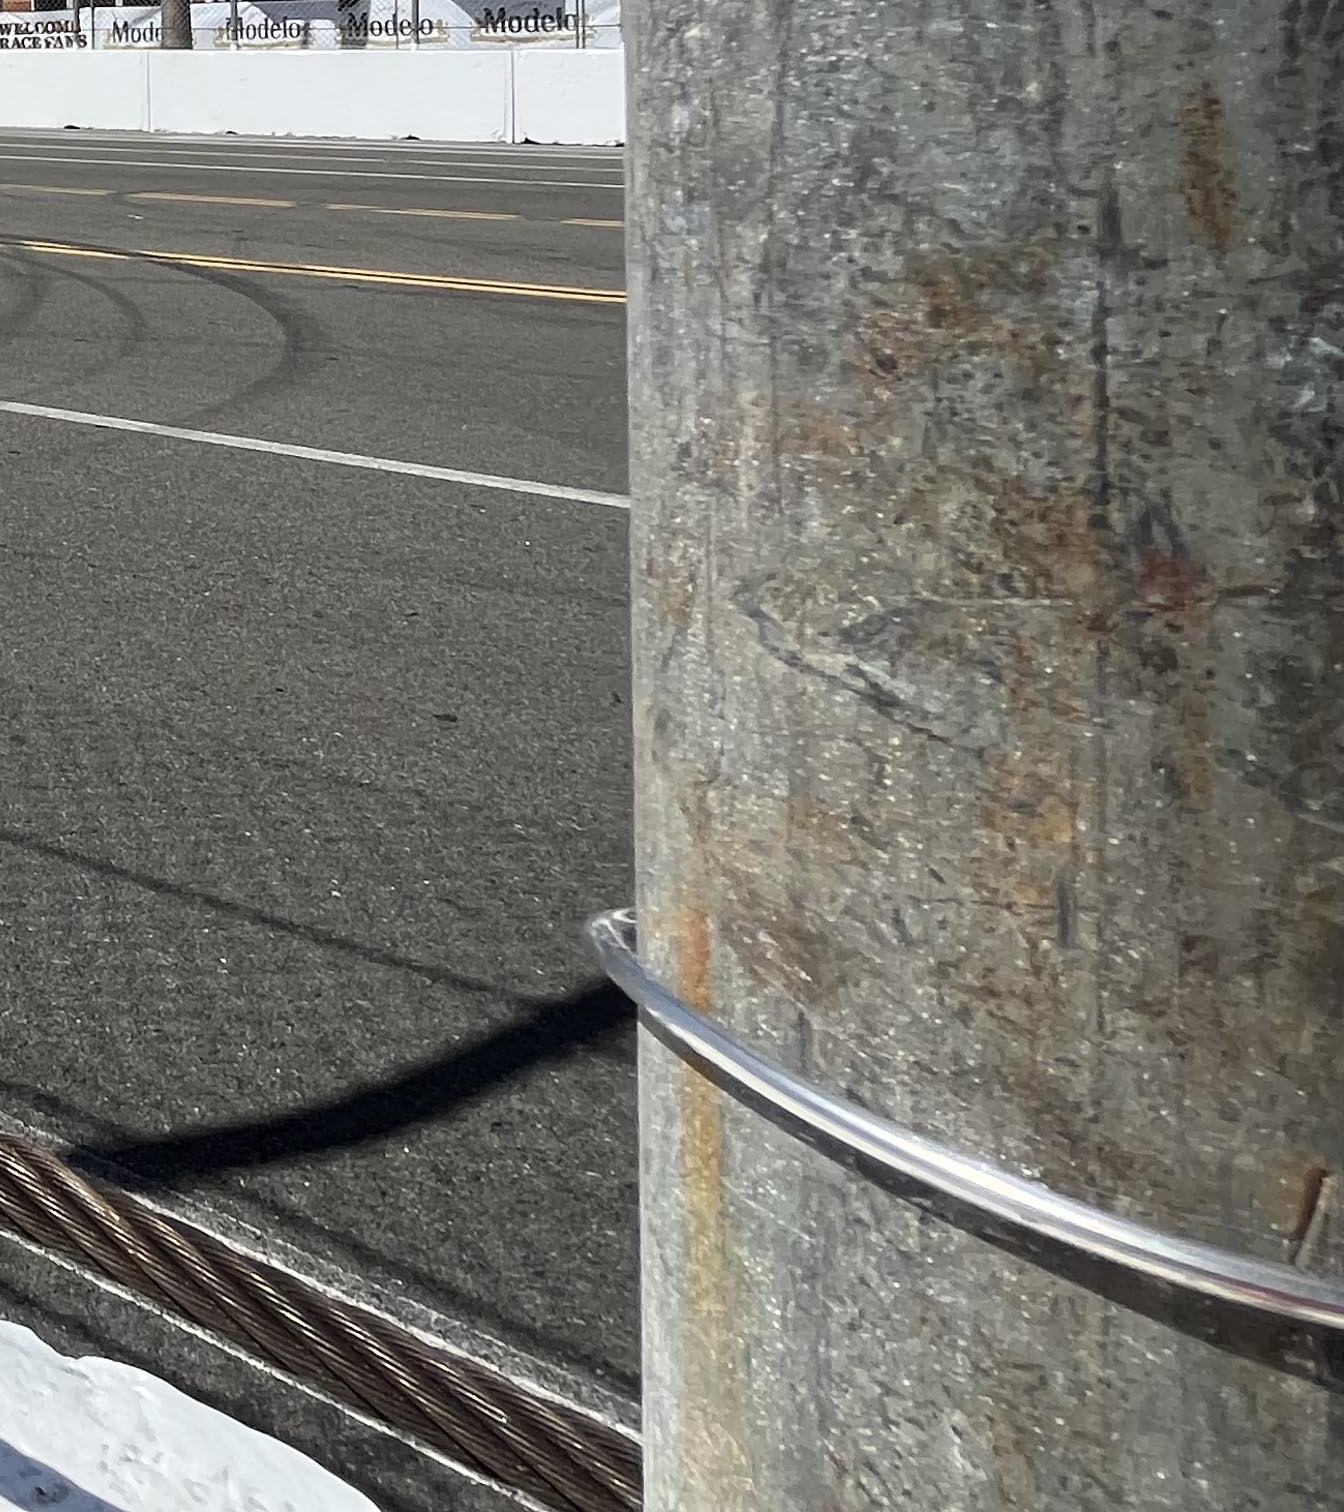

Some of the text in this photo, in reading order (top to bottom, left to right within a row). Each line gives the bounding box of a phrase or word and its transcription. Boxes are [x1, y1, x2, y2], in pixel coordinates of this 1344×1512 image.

[112, 20, 162, 44] Mode
[347, 12, 434, 38] Modeo
[484, 7, 579, 33] Modelo
[0, 36, 42, 49] RACE
